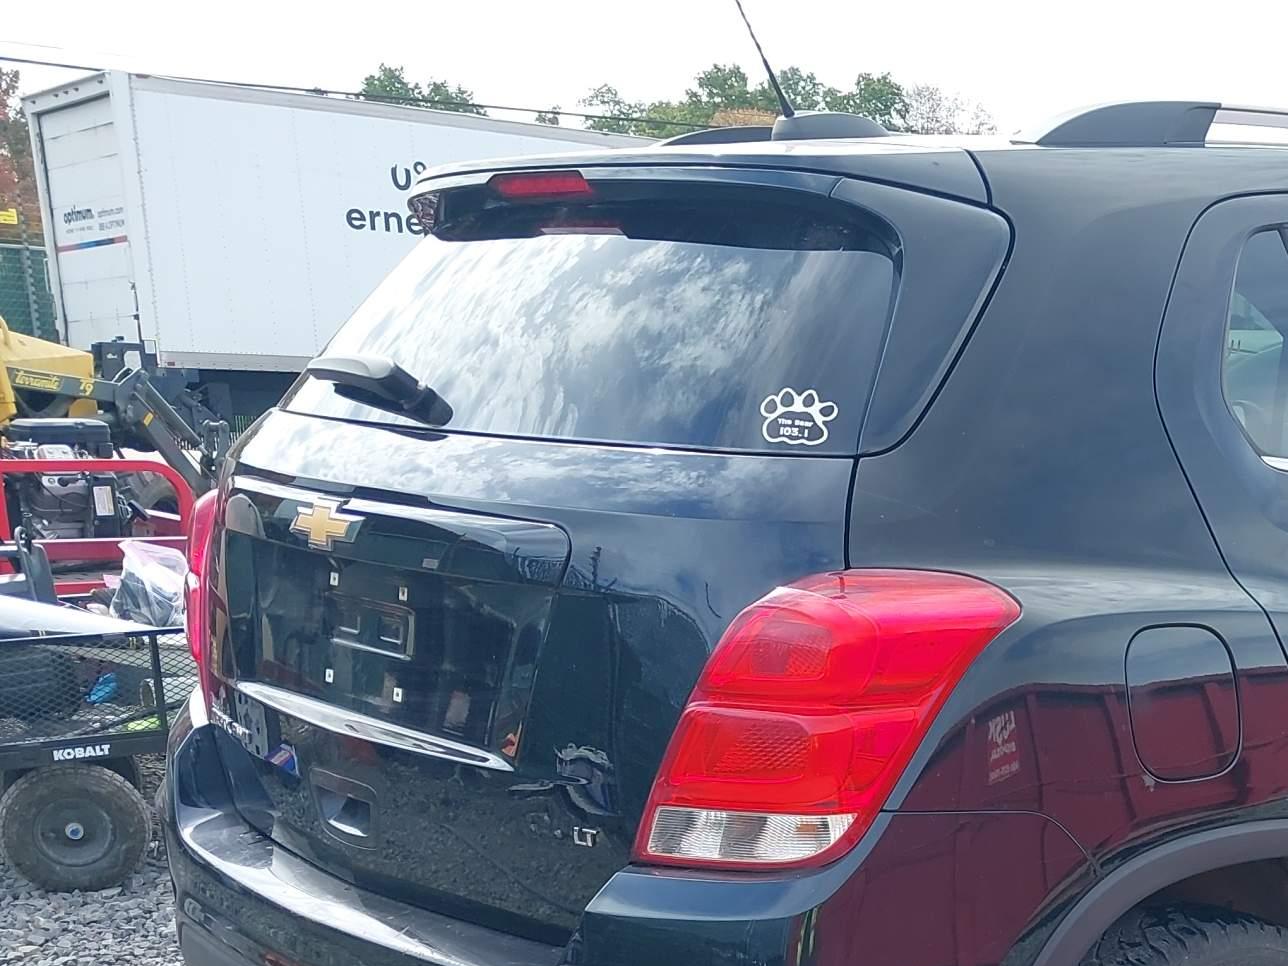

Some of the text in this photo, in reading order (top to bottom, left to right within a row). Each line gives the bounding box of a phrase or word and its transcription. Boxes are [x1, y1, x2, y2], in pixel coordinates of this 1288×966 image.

[779, 427, 809, 438] 103.1
[53, 744, 111, 761] KOBALT
[573, 826, 597, 847] LT
